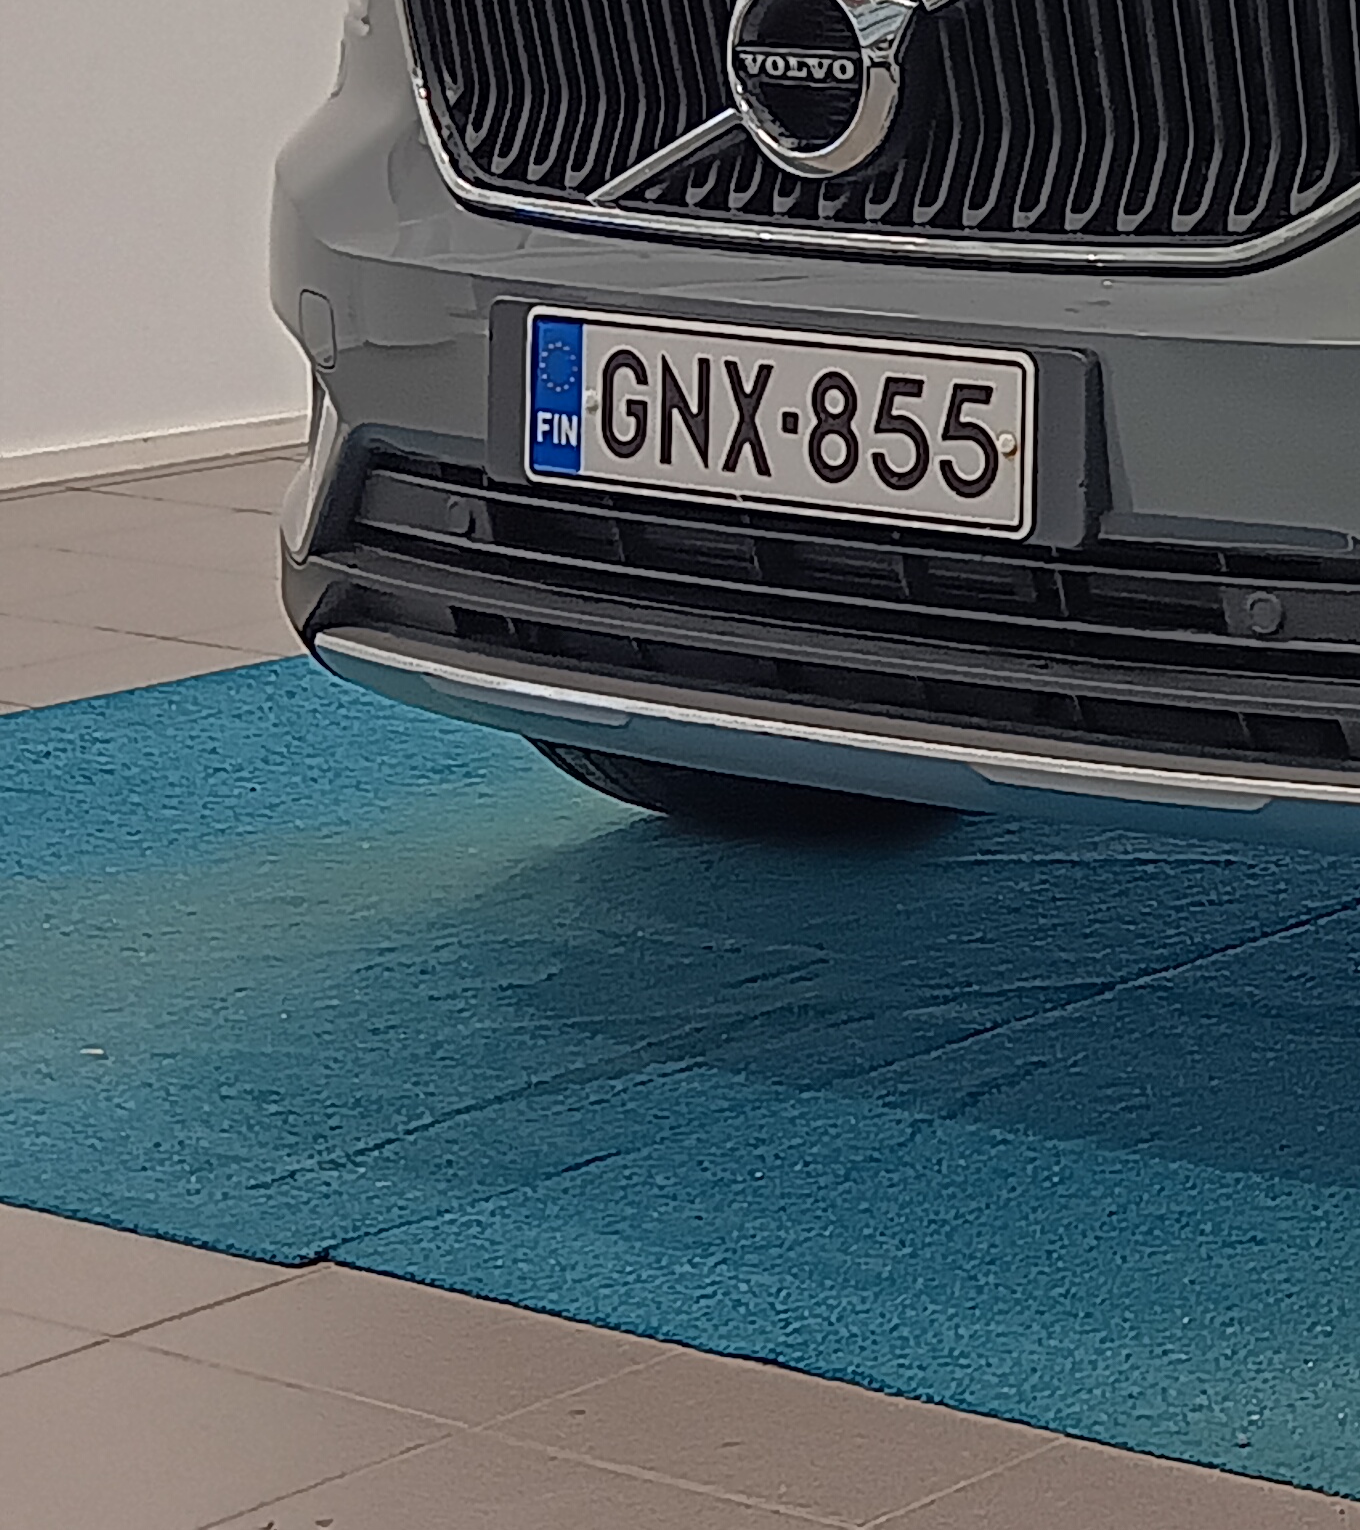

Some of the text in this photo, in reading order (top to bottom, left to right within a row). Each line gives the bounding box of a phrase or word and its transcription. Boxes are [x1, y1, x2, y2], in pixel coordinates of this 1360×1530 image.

[739, 53, 855, 80] VOLVO
[536, 411, 577, 447] FIN
[601, 348, 999, 499] GNX-855
